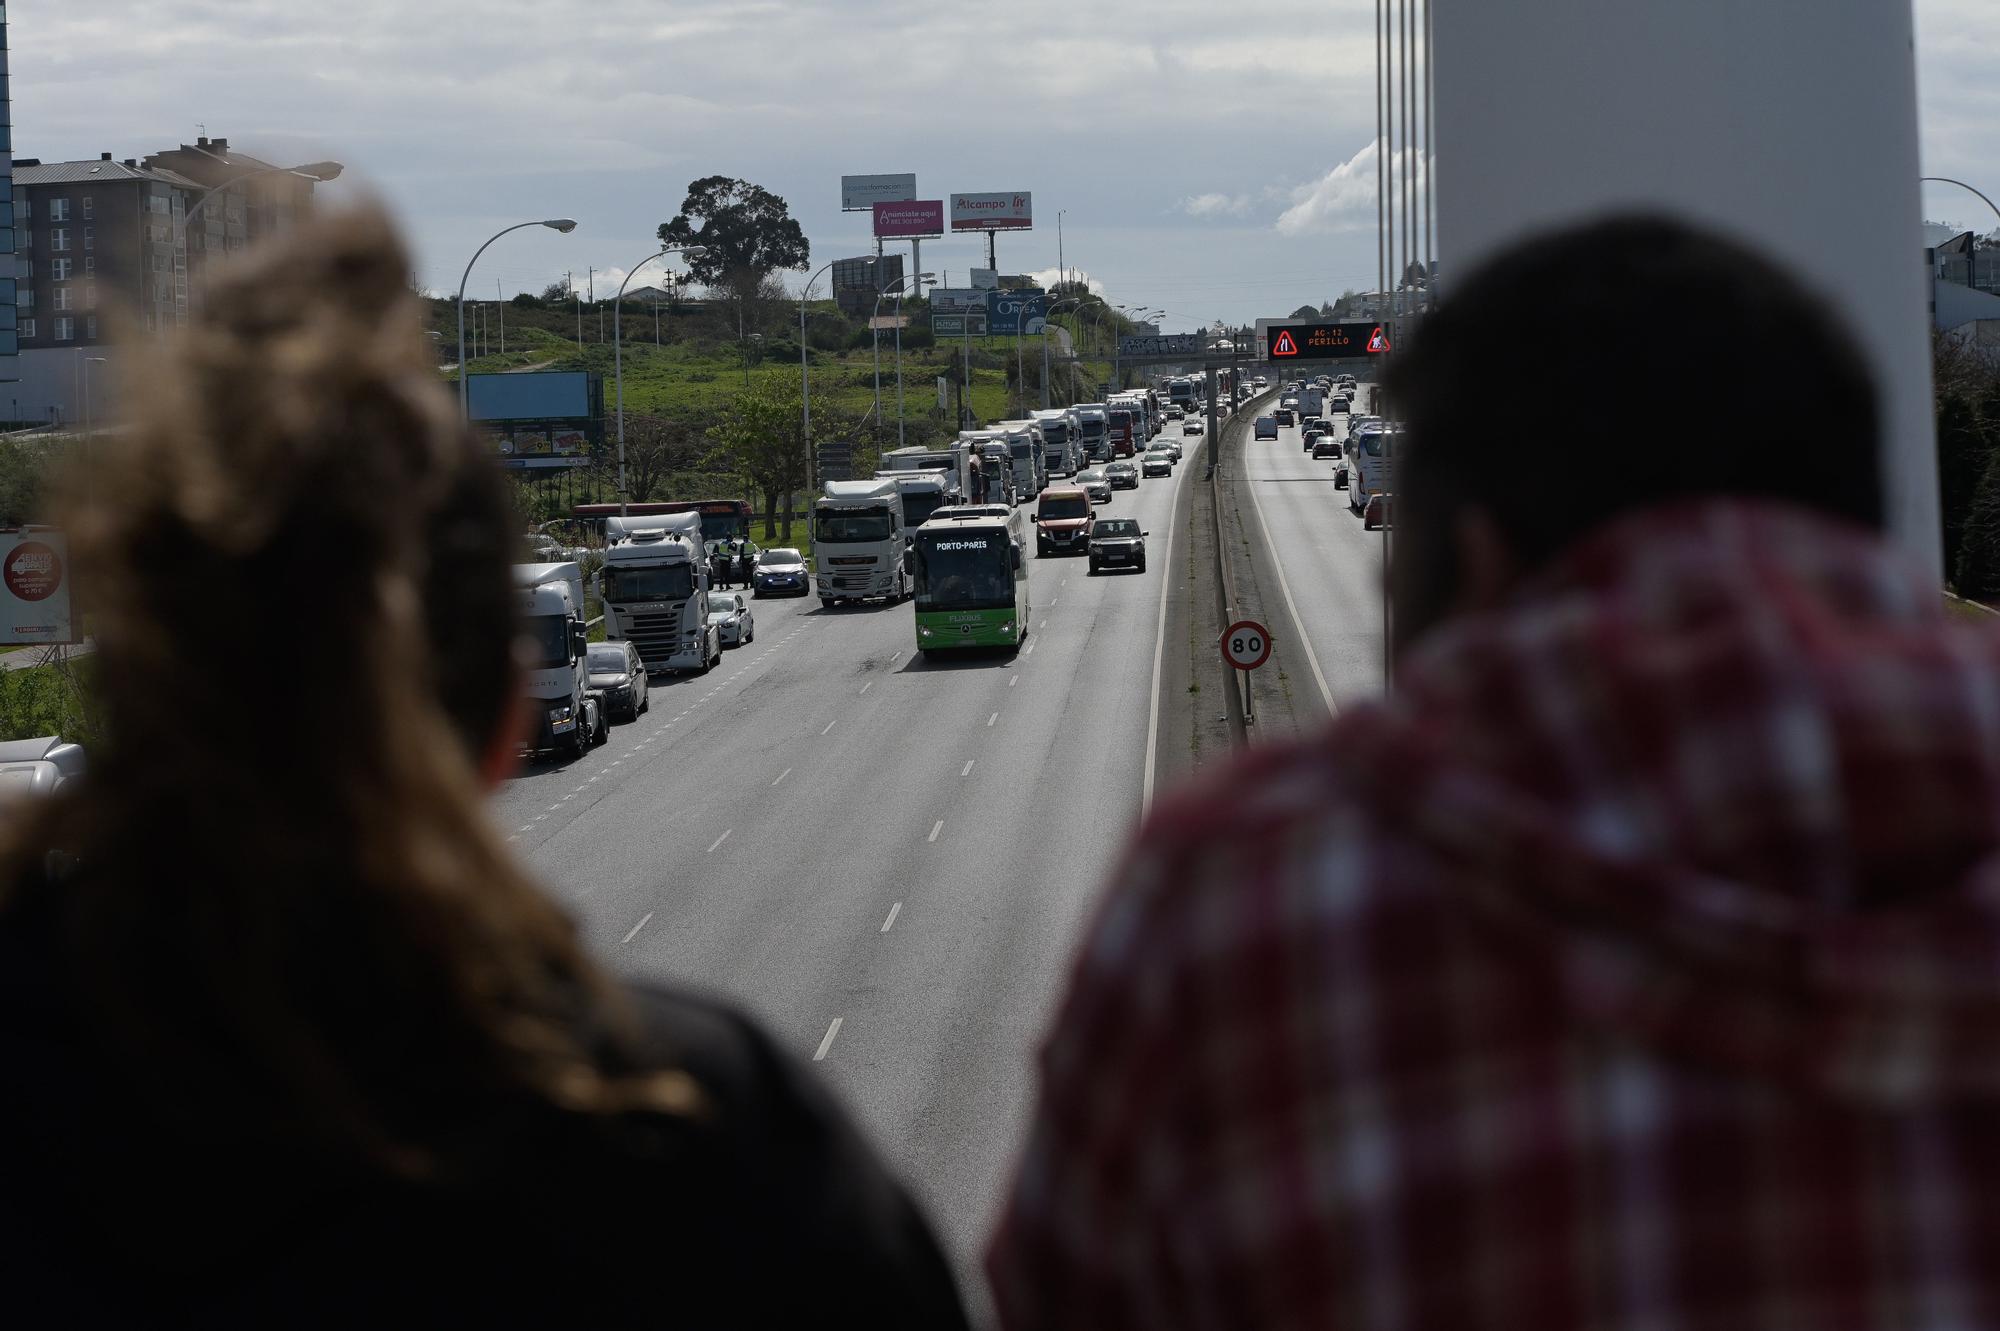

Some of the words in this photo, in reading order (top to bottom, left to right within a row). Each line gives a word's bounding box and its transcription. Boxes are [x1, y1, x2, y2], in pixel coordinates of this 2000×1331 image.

[957, 199, 1006, 211] Alcampo
[1308, 337, 1350, 346] PERILLO
[936, 541, 987, 551] PORTO-PARIS
[1232, 637, 1262, 654] 80
